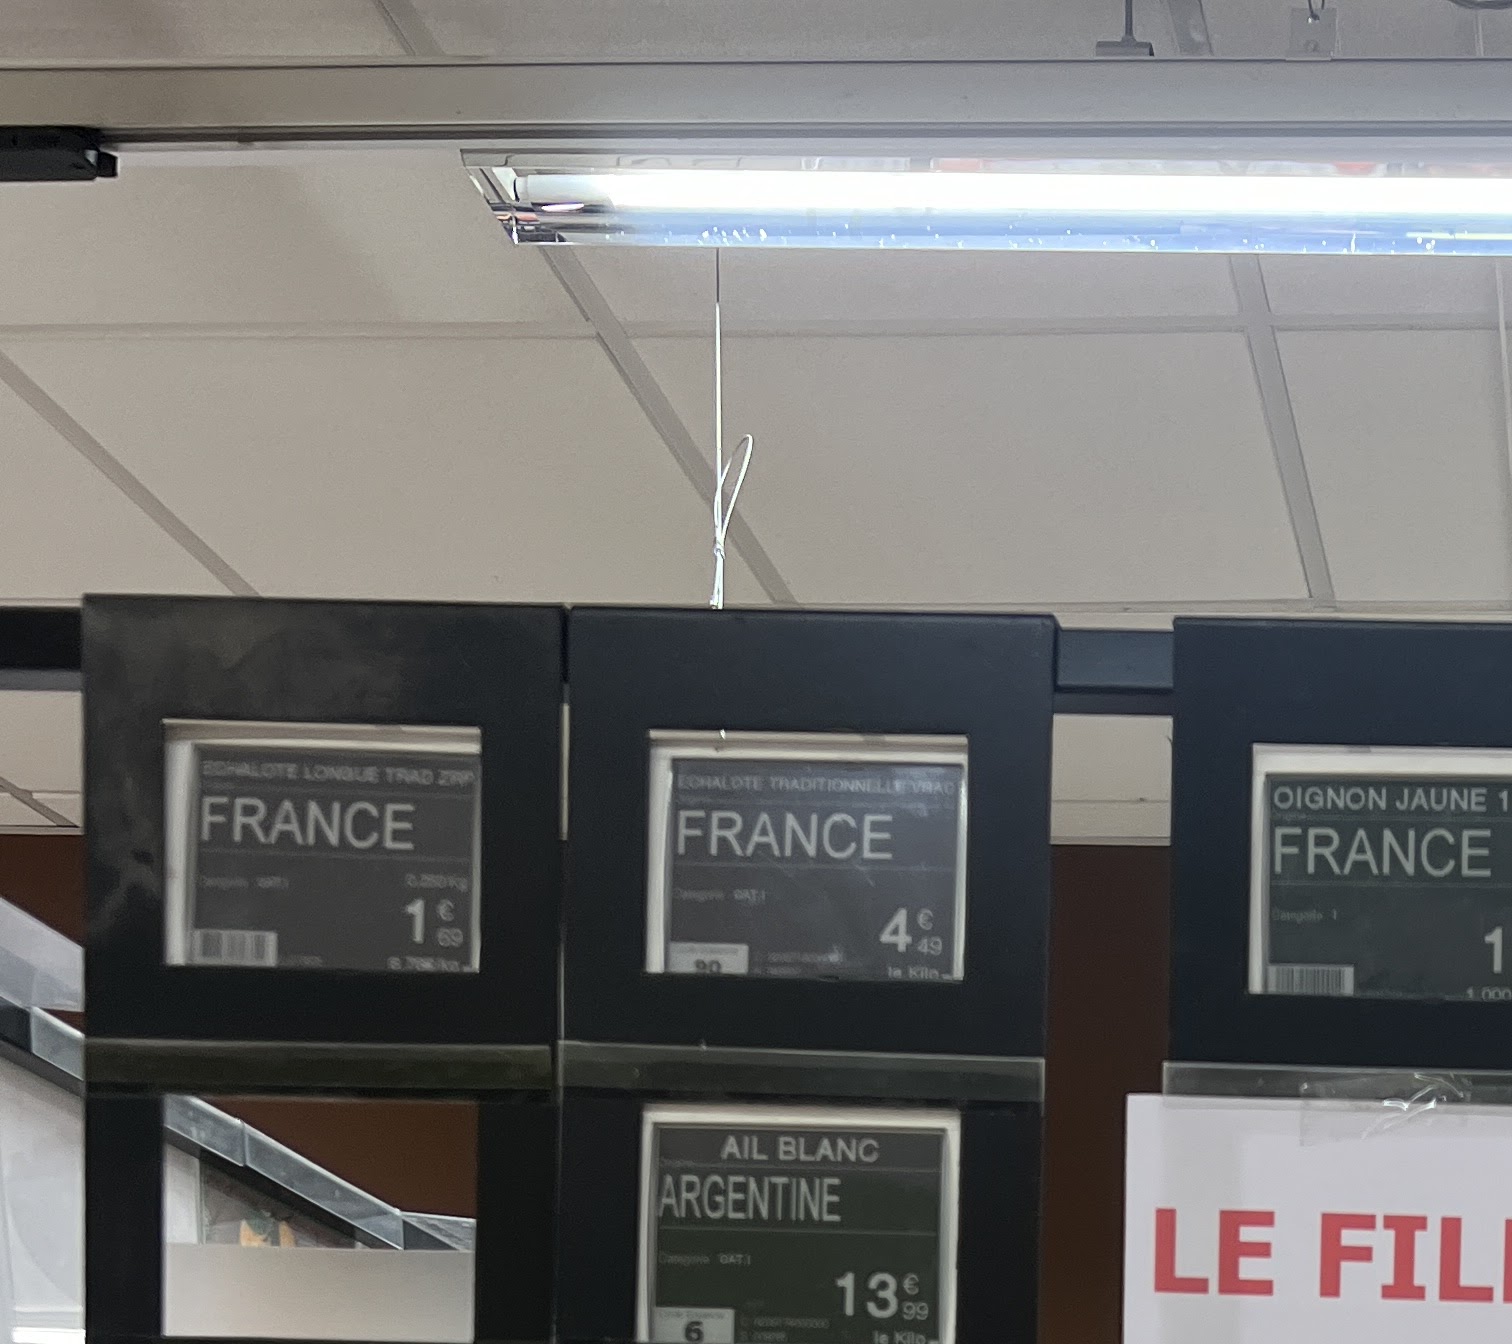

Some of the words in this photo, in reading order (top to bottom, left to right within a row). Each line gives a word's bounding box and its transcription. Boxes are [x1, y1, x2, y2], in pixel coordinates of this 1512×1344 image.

[1273, 785, 1387, 812] OIGNON
[1396, 786, 1488, 813] JAUNE
[200, 796, 416, 851] FRANCE
[676, 809, 894, 861] FRANCE
[1273, 826, 1493, 879] FRANCE
[406, 898, 425, 945] 1
[436, 900, 455, 923] €
[879, 907, 913, 953] 4
[917, 908, 935, 931] €
[917, 937, 943, 957] 49
[1484, 926, 1503, 974] 1
[720, 1136, 768, 1161] AIL
[777, 1137, 881, 1163] BLANC
[658, 1174, 842, 1223] ARGENTINE
[1154, 1207, 1276, 1297] LE
[835, 1271, 899, 1319] 13
[903, 1273, 920, 1296] €
[684, 1320, 705, 1343] 6
[902, 1302, 929, 1321] 99
